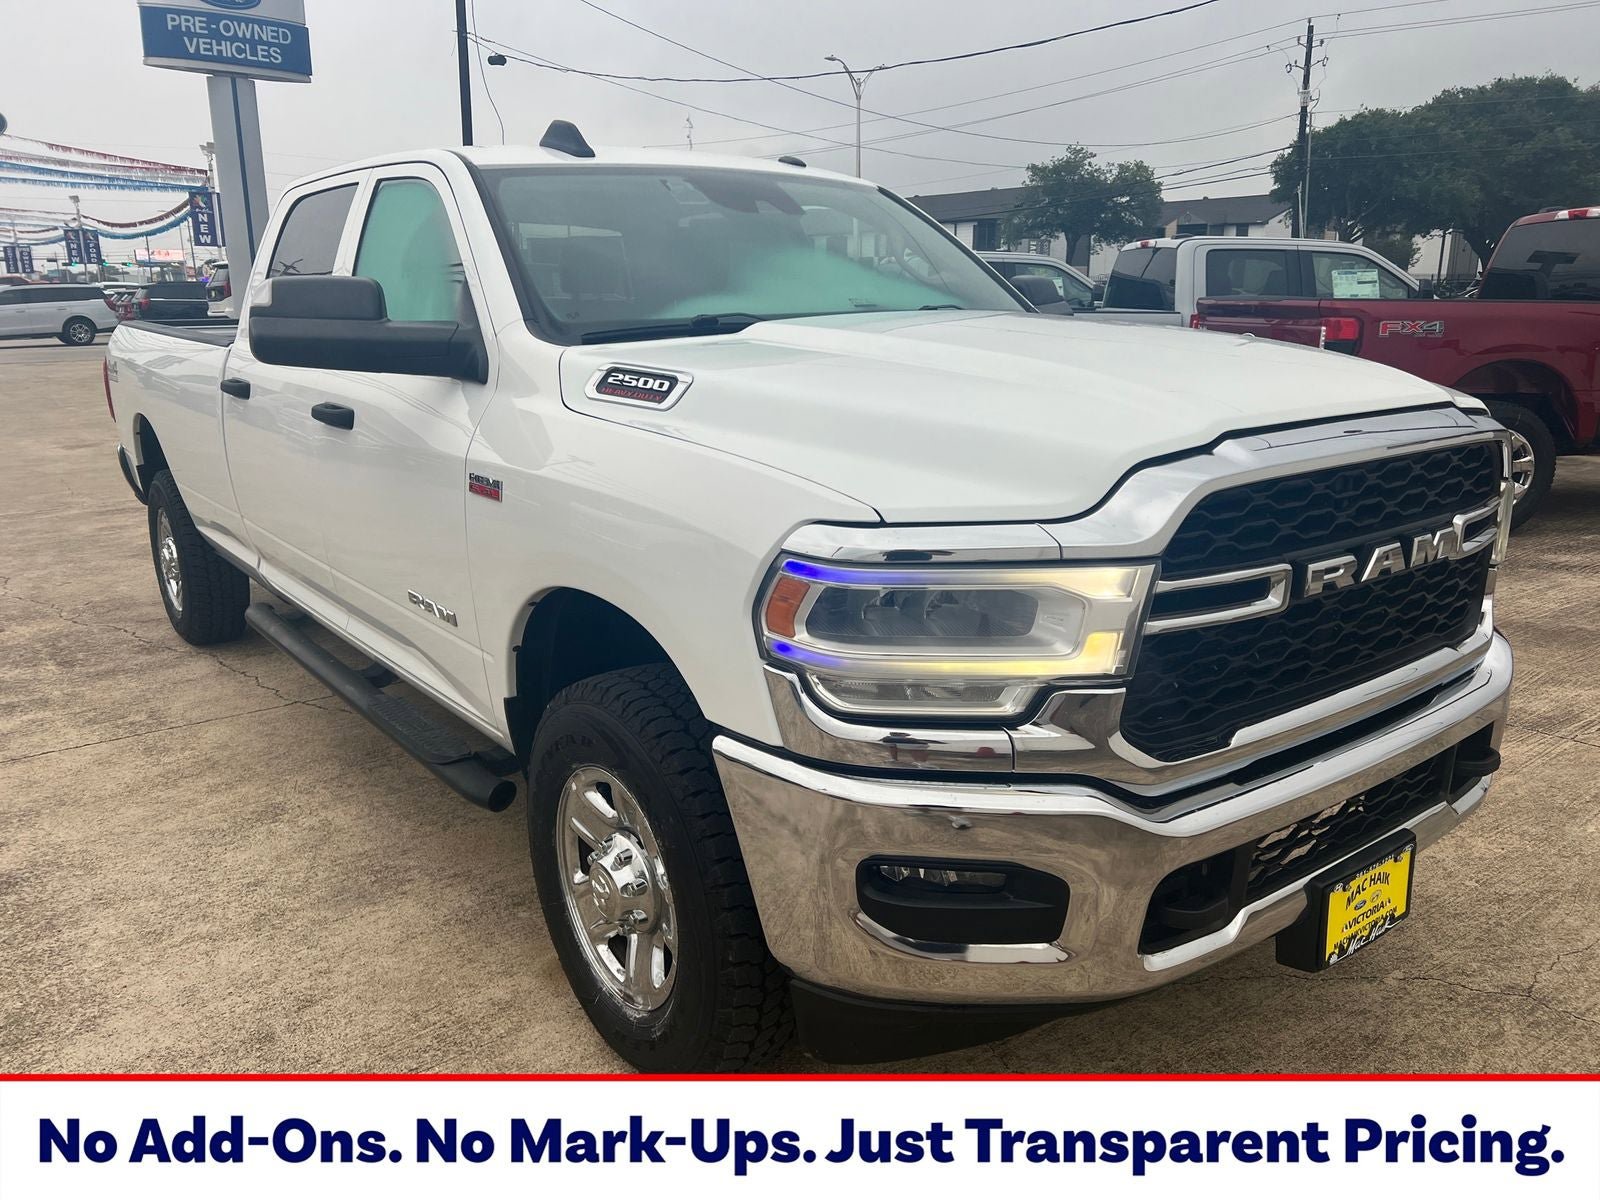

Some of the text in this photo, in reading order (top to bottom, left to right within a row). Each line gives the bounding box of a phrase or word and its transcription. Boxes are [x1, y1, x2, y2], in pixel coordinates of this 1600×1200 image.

[184, 36, 282, 63] VEHICLES
[198, 213, 212, 244] NEW
[70, 243, 79, 262] NEW
[1379, 320, 1444, 337] FX4
[608, 373, 670, 391] 2500
[1304, 527, 1459, 598] RAM
[408, 589, 458, 627] RAM
[1346, 878, 1367, 910] MAC
[1369, 872, 1390, 887] HAIK
[1348, 901, 1385, 929] VICTORIA
